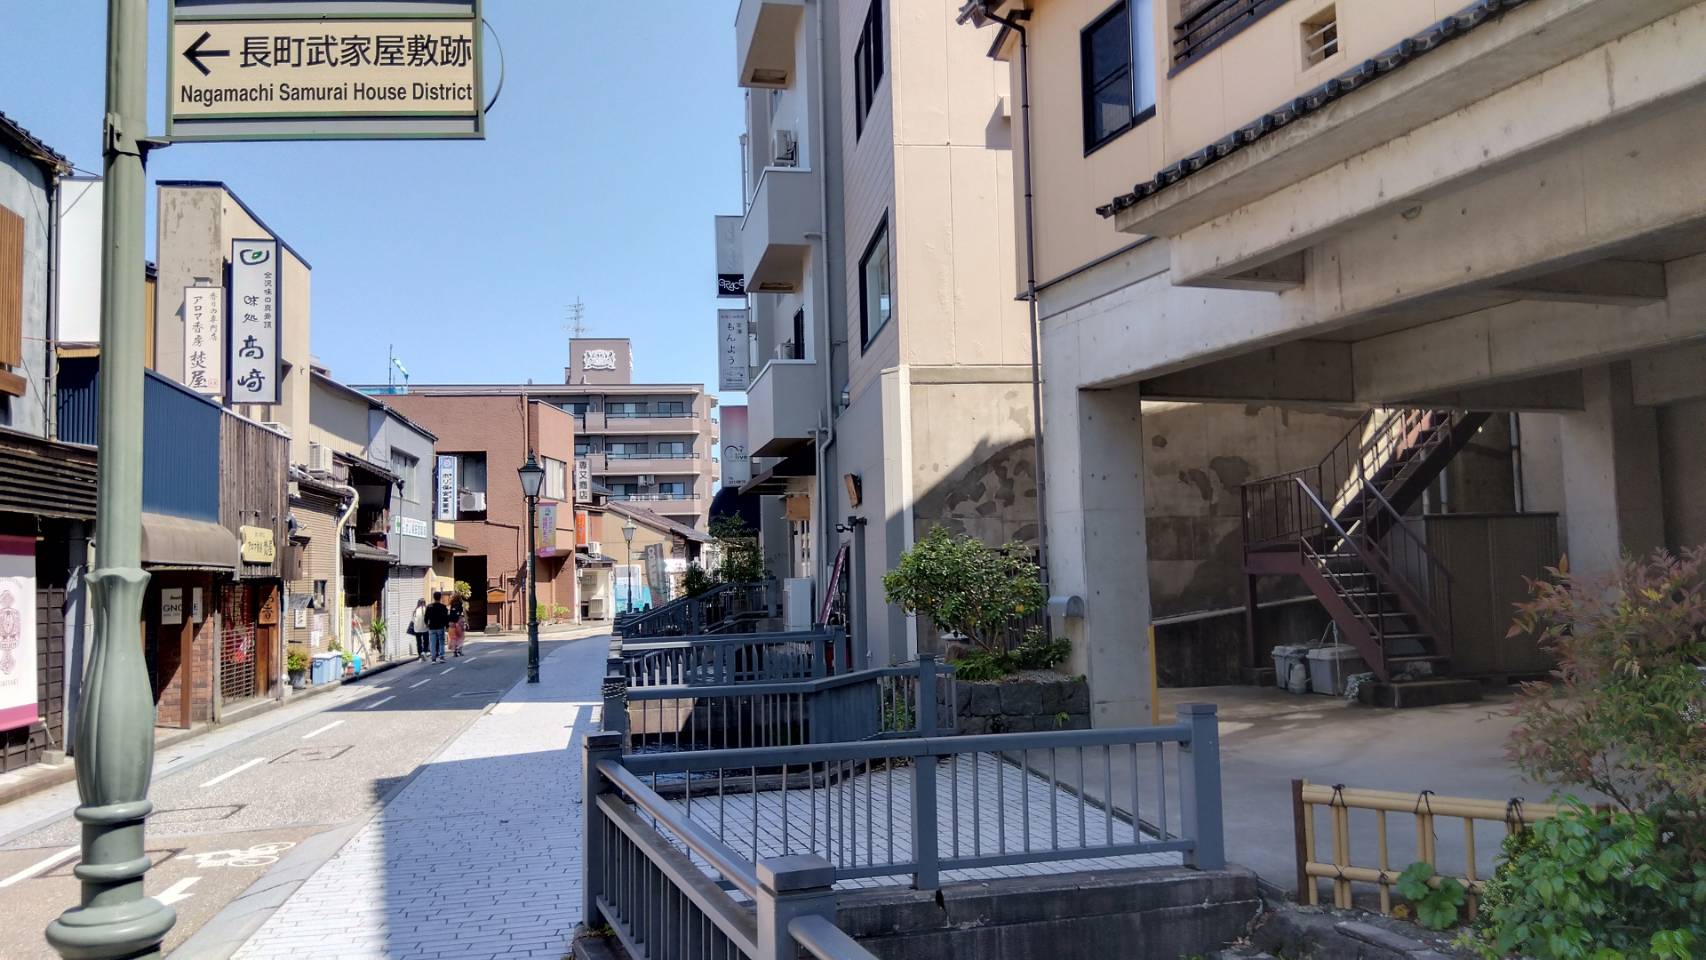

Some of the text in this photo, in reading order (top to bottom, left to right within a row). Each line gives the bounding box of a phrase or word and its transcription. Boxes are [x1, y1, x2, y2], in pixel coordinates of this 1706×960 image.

[239, 34, 472, 68] 長町武家屋敷跡
[181, 82, 472, 106] Nagamachi Samurai House District
